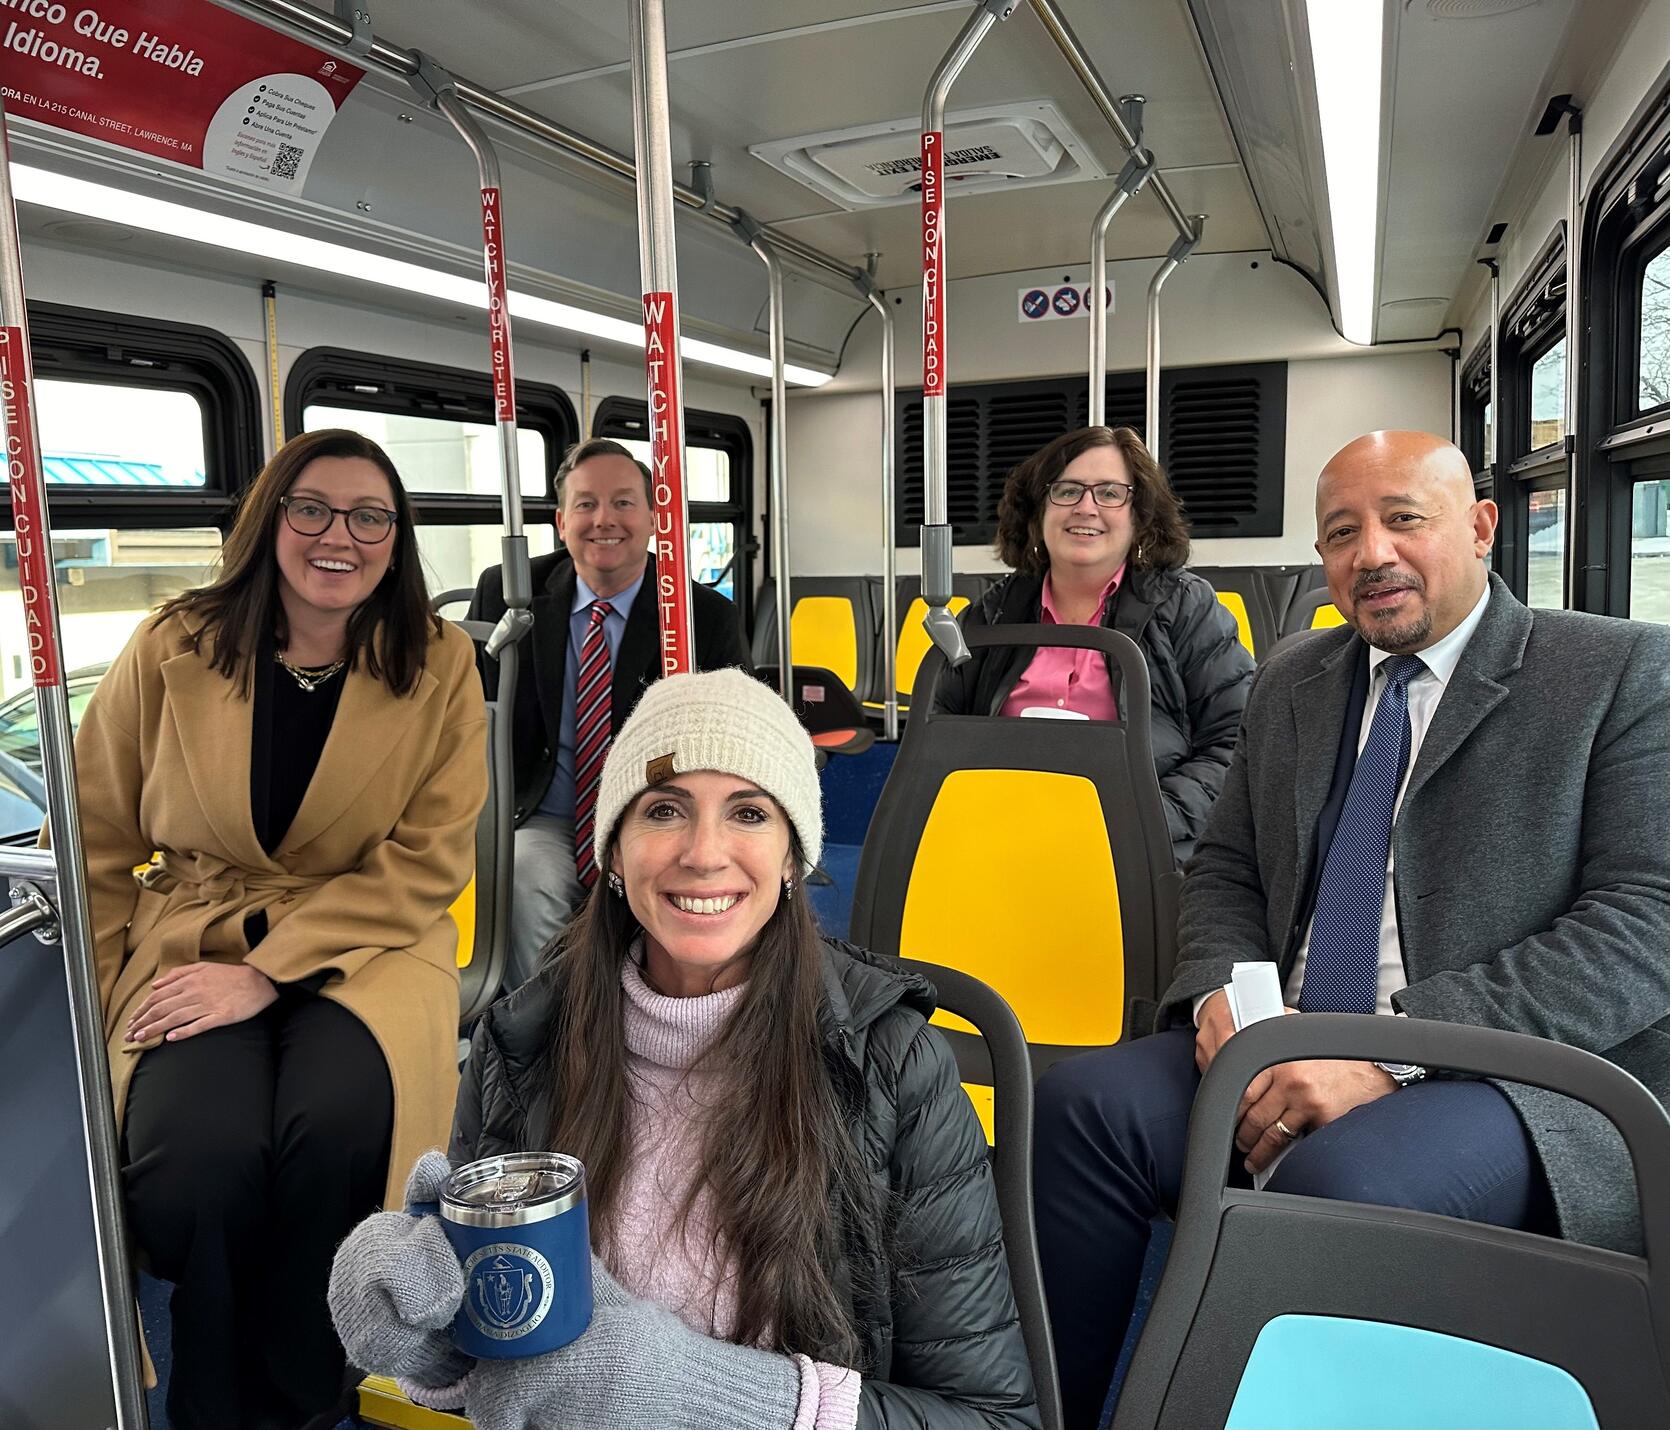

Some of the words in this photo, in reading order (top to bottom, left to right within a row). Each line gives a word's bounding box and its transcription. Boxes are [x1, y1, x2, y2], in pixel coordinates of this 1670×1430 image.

[0, 0, 67, 24] nco
[74, 9, 129, 48] Que
[132, 31, 205, 77] Habla
[3, 22, 104, 79] Idioma.
[23, 93, 37, 105] EN
[38, 98, 50, 109] LA
[51, 102, 68, 114] 215
[68, 108, 98, 124] CANAL
[99, 117, 132, 135] STREET,
[134, 128, 179, 149] LAWRENCE,
[180, 142, 193, 152] MA
[256, 110, 273, 120] Aplica
[273, 115, 285, 125] Para
[262, 98, 276, 108] Paga
[276, 104, 286, 112] Sus
[286, 107, 306, 119] Cuentas
[268, 88, 284, 99] Cobra
[284, 94, 294, 102] Sus
[264, 125, 275, 134] Una
[950, 145, 993, 158] SALIDA
[877, 167, 909, 176] EXIT
[924, 135, 936, 204] PISE
[482, 193, 498, 273] WATCH
[925, 211, 937, 261] CON
[489, 281, 504, 343] YOUR
[926, 268, 939, 387] CUIDADO
[0, 331, 18, 425] PISE
[494, 350, 507, 412] STEP
[644, 301, 668, 441] WATCH
[7, 436, 27, 503] CON
[654, 455, 674, 562] YOUR
[15, 514, 47, 674] CUIDADO
[660, 574, 678, 679] STEP
[506, 1245, 534, 1259] STATE
[533, 1255, 552, 1290] AUDITOR
